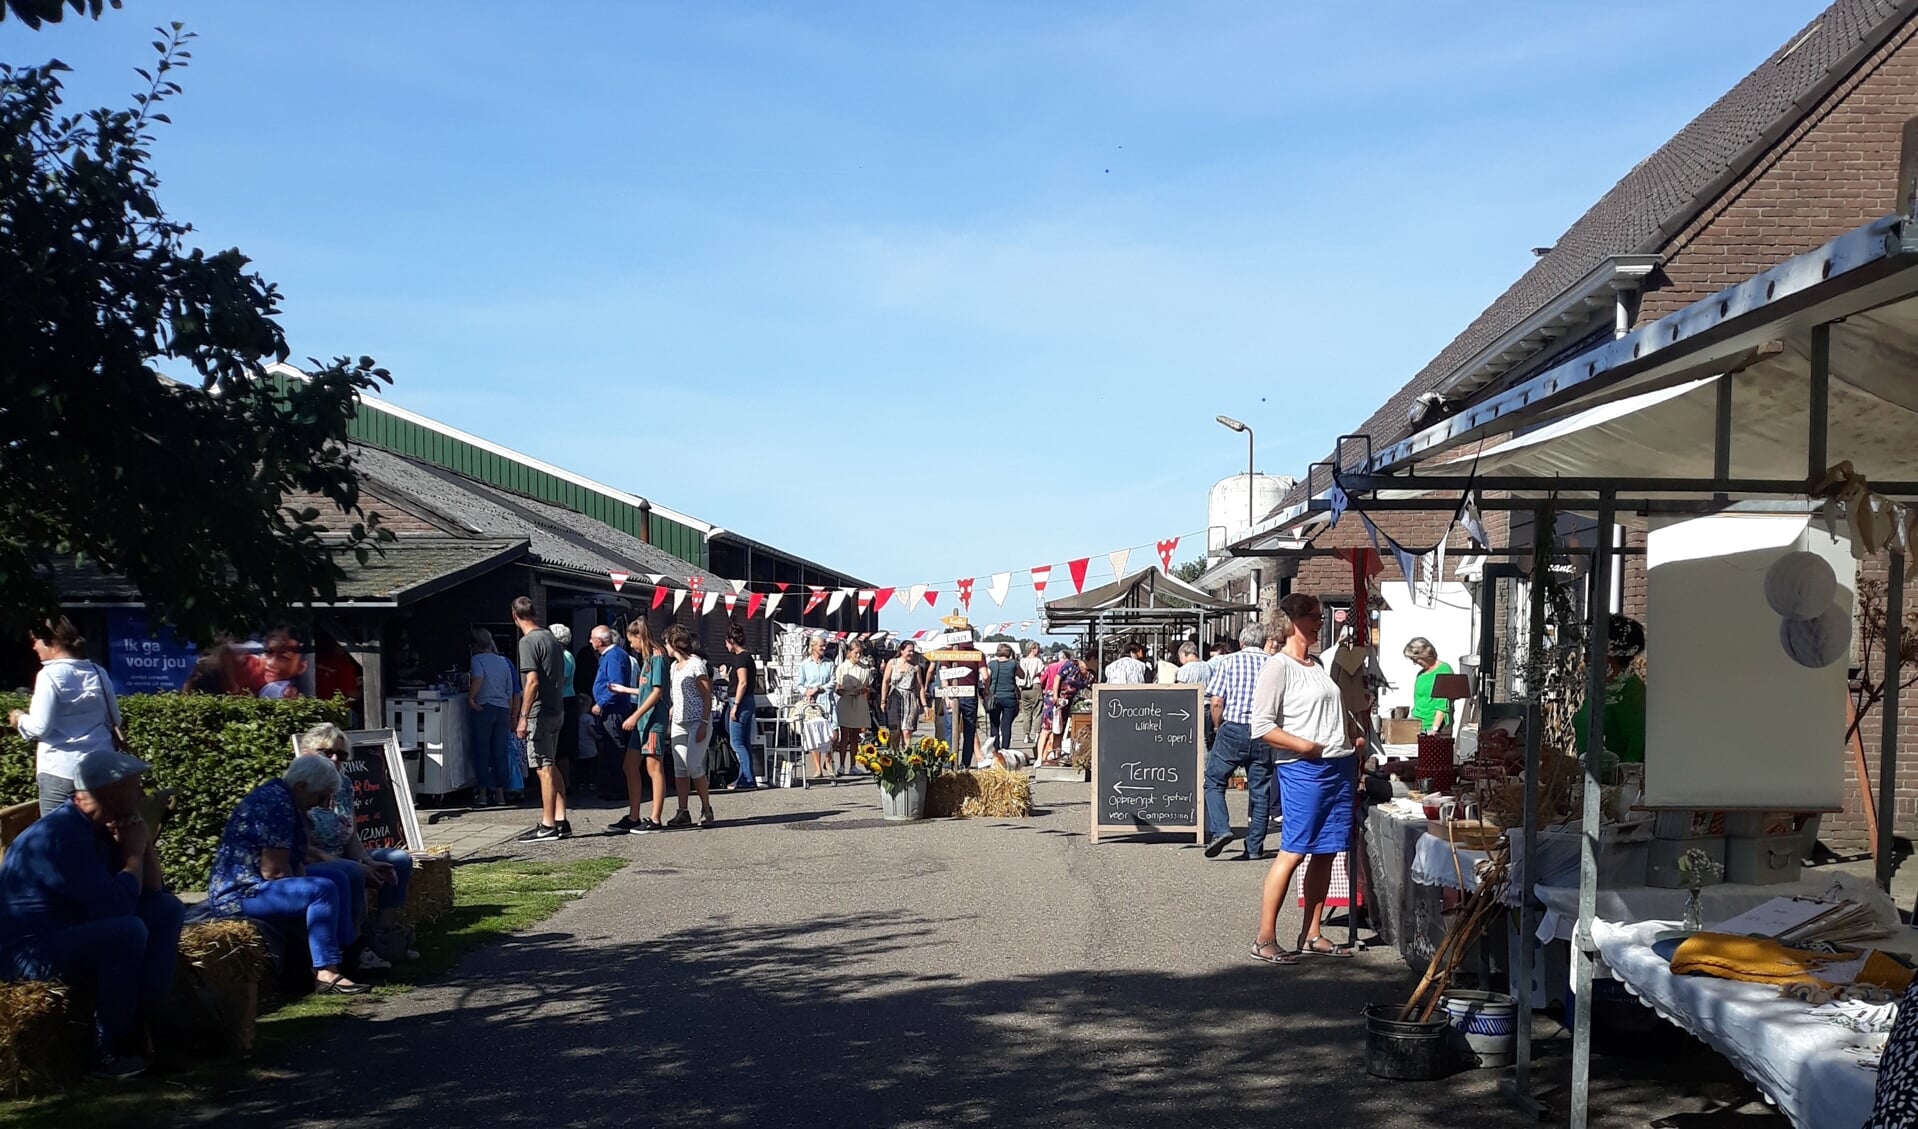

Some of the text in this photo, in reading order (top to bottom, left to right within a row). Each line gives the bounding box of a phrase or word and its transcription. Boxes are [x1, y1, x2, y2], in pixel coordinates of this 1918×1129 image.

[124, 639, 160, 655] Ik ga
[126, 655, 186, 671] voor jou
[1108, 699, 1162, 718] Brocante
[1135, 719, 1162, 731] winkel
[1154, 734, 1164, 743] is
[340, 761, 369, 773] RINK
[1121, 761, 1178, 782] Terras
[1108, 793, 1158, 810] Opbrengst
[1109, 808, 1195, 823] voor Compassion!
[356, 825, 391, 841] NZANIA
